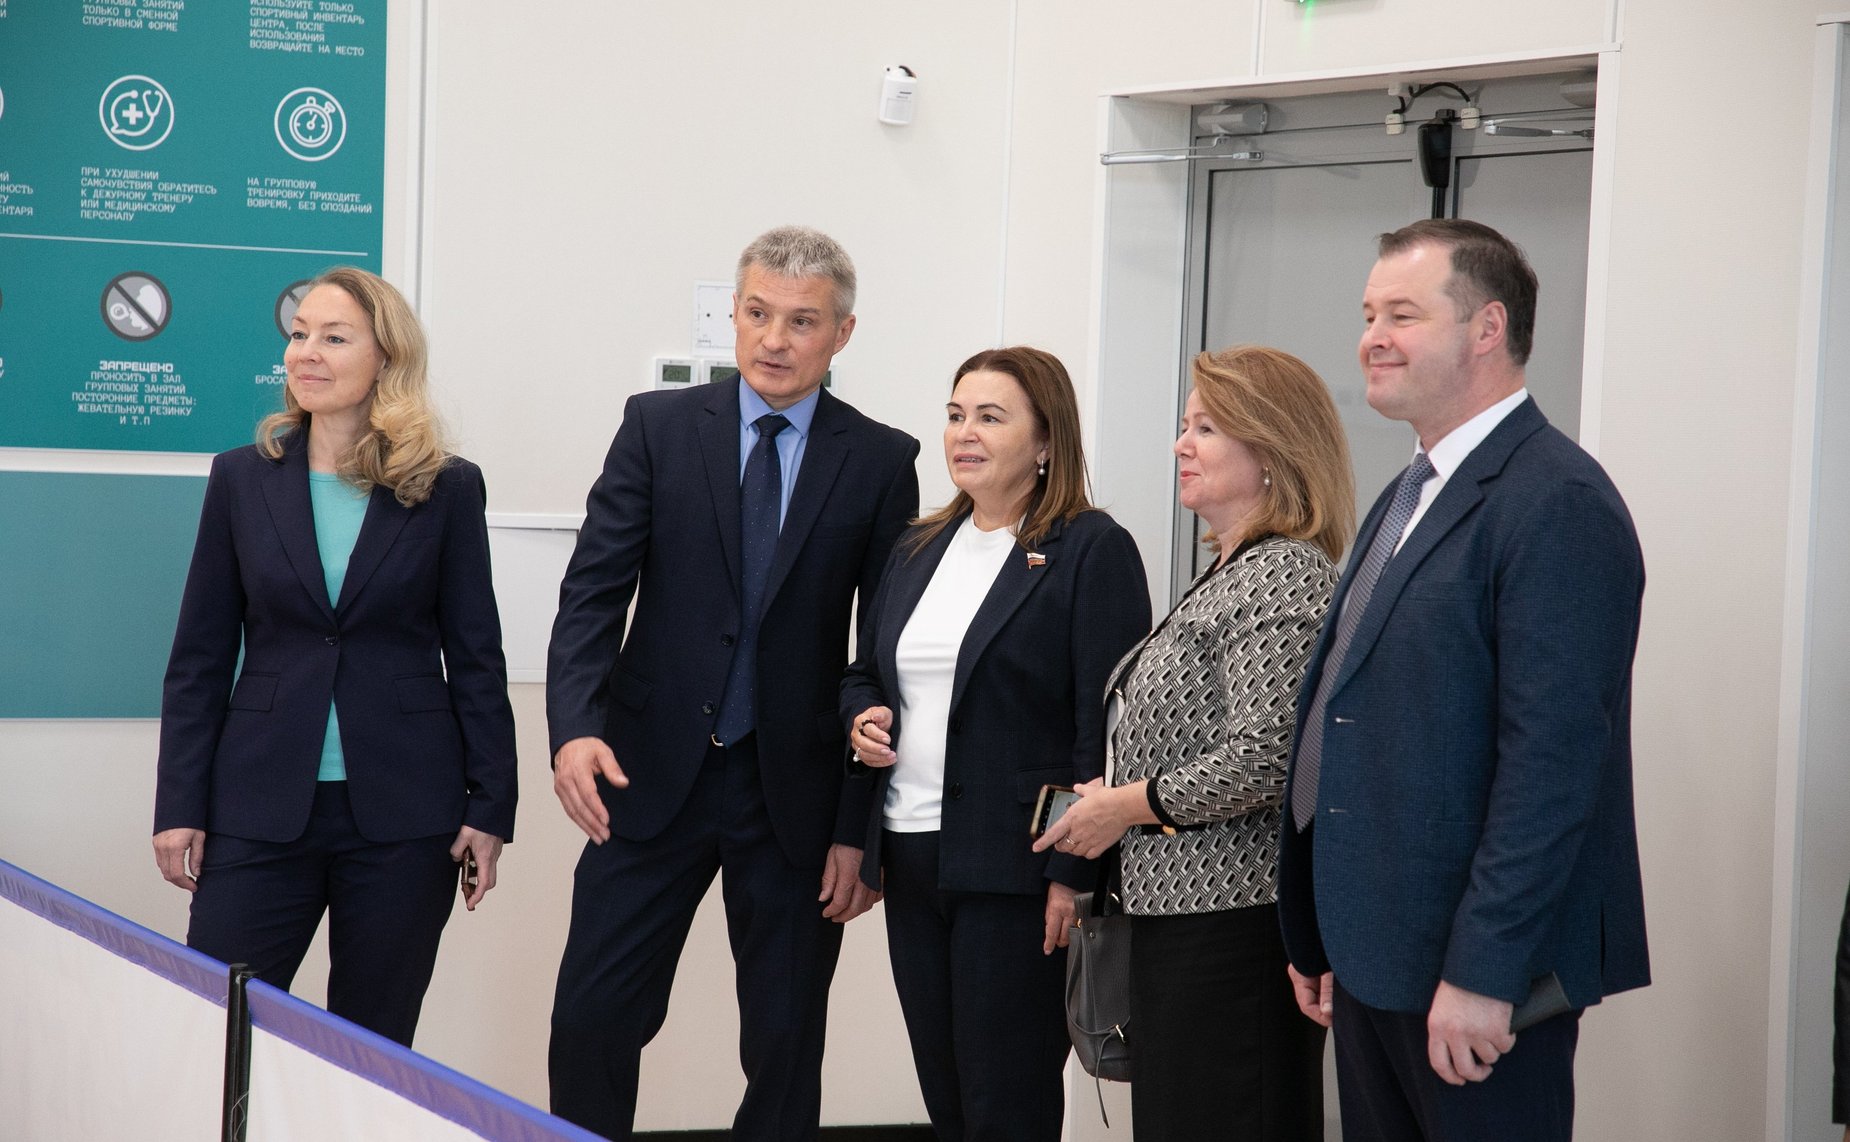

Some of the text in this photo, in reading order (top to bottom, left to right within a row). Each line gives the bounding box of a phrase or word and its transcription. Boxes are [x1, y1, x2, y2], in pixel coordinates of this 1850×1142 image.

[83, 5, 178, 20] ТОЛЬКО В СМЕННОЙ
[319, 2, 354, 12] ТОЛЬКО
[250, 7, 365, 25] СПОРТИВНЫЙ ИНВЕНТАРЬ
[82, 15, 178, 32] СПОРТИВНОЙ ФОРМЕ
[250, 18, 324, 32] ЦЕНТРА, ПОСЛЕ
[250, 29, 325, 42] ИСПОЛЬЗОВАНИЯ
[250, 39, 365, 56] ВОЗВРАЩАЙТЕ НА МЕСТО
[81, 167, 159, 180] ПРИ УХУДШЕНИИ
[80, 177, 217, 195] САМОЧУВСТВИЯ ОБРАТИТЕСЬ
[247, 177, 317, 190] НА ГРУППОВУЮ
[81, 188, 194, 204] К ДЕЖУРНОМУ ТРЕНЕРУ
[248, 187, 361, 203] ТРЕНИРОВКУ ПРИХОДИТЕ
[81, 199, 176, 213] ИЛИ МЕДИЦИНСКОМУ
[247, 197, 372, 214] ВОВРЕМЯ, БЕЗ ОПОЗДАНИЙ
[80, 210, 134, 221] ПЕРСОНАЛУ
[100, 360, 174, 373] ЗАПРЕЩЕНО
[90, 371, 181, 383] ПРОНОСИТЬ В ЗАЛ
[85, 381, 186, 395] ГРУППОВЫХ ЗАНЯТИЙ
[72, 391, 197, 406] ПОСТОРОННИЕ ПРЕДМЕТЫ:
[78, 403, 192, 417] ЖЕВАТЕЛЬНУЮ РЕЗИНКУ
[119, 416, 151, 425] И Т.П
